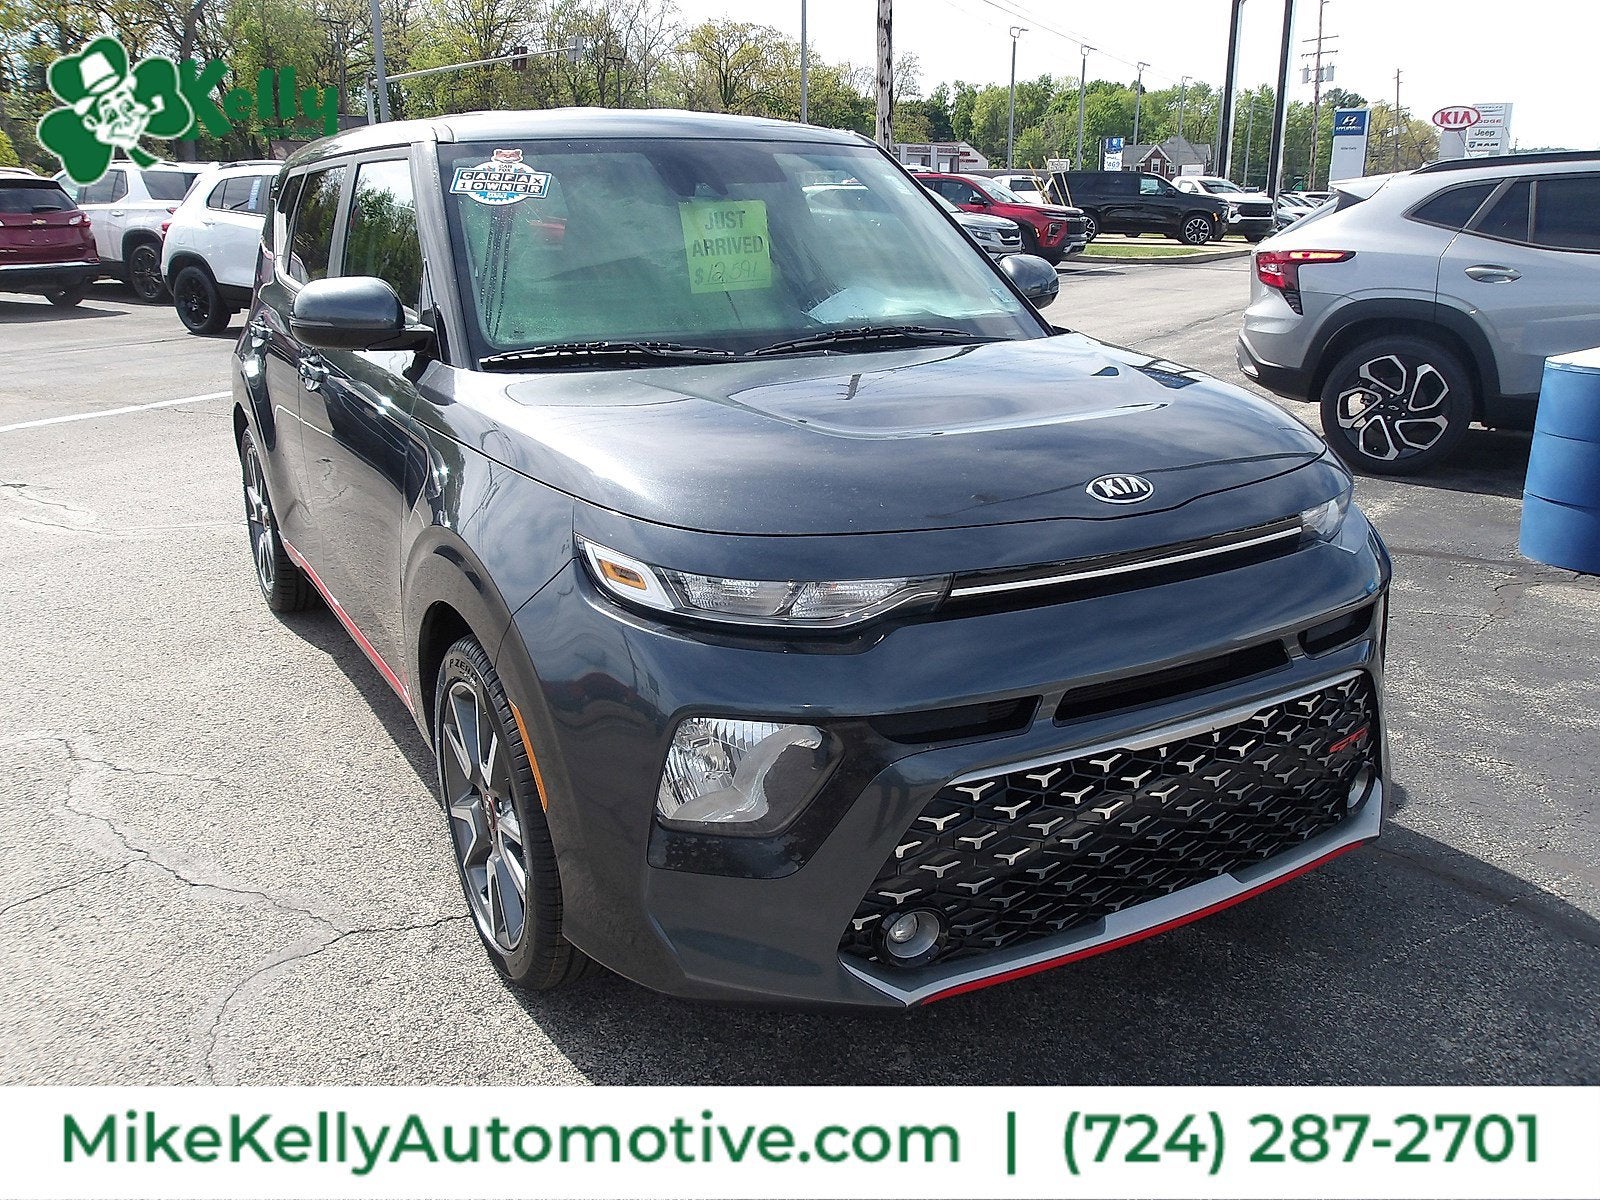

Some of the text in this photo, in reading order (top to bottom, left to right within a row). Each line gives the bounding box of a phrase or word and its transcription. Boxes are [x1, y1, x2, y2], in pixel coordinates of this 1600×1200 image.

[1440, 110, 1472, 125] KIA
[1474, 129, 1496, 137] Jeep
[461, 171, 542, 185] CARFAX
[471, 181, 543, 193] OWNER
[704, 210, 746, 230] JUST
[692, 236, 764, 257] ARRIVED
[1096, 476, 1149, 498] KIA
